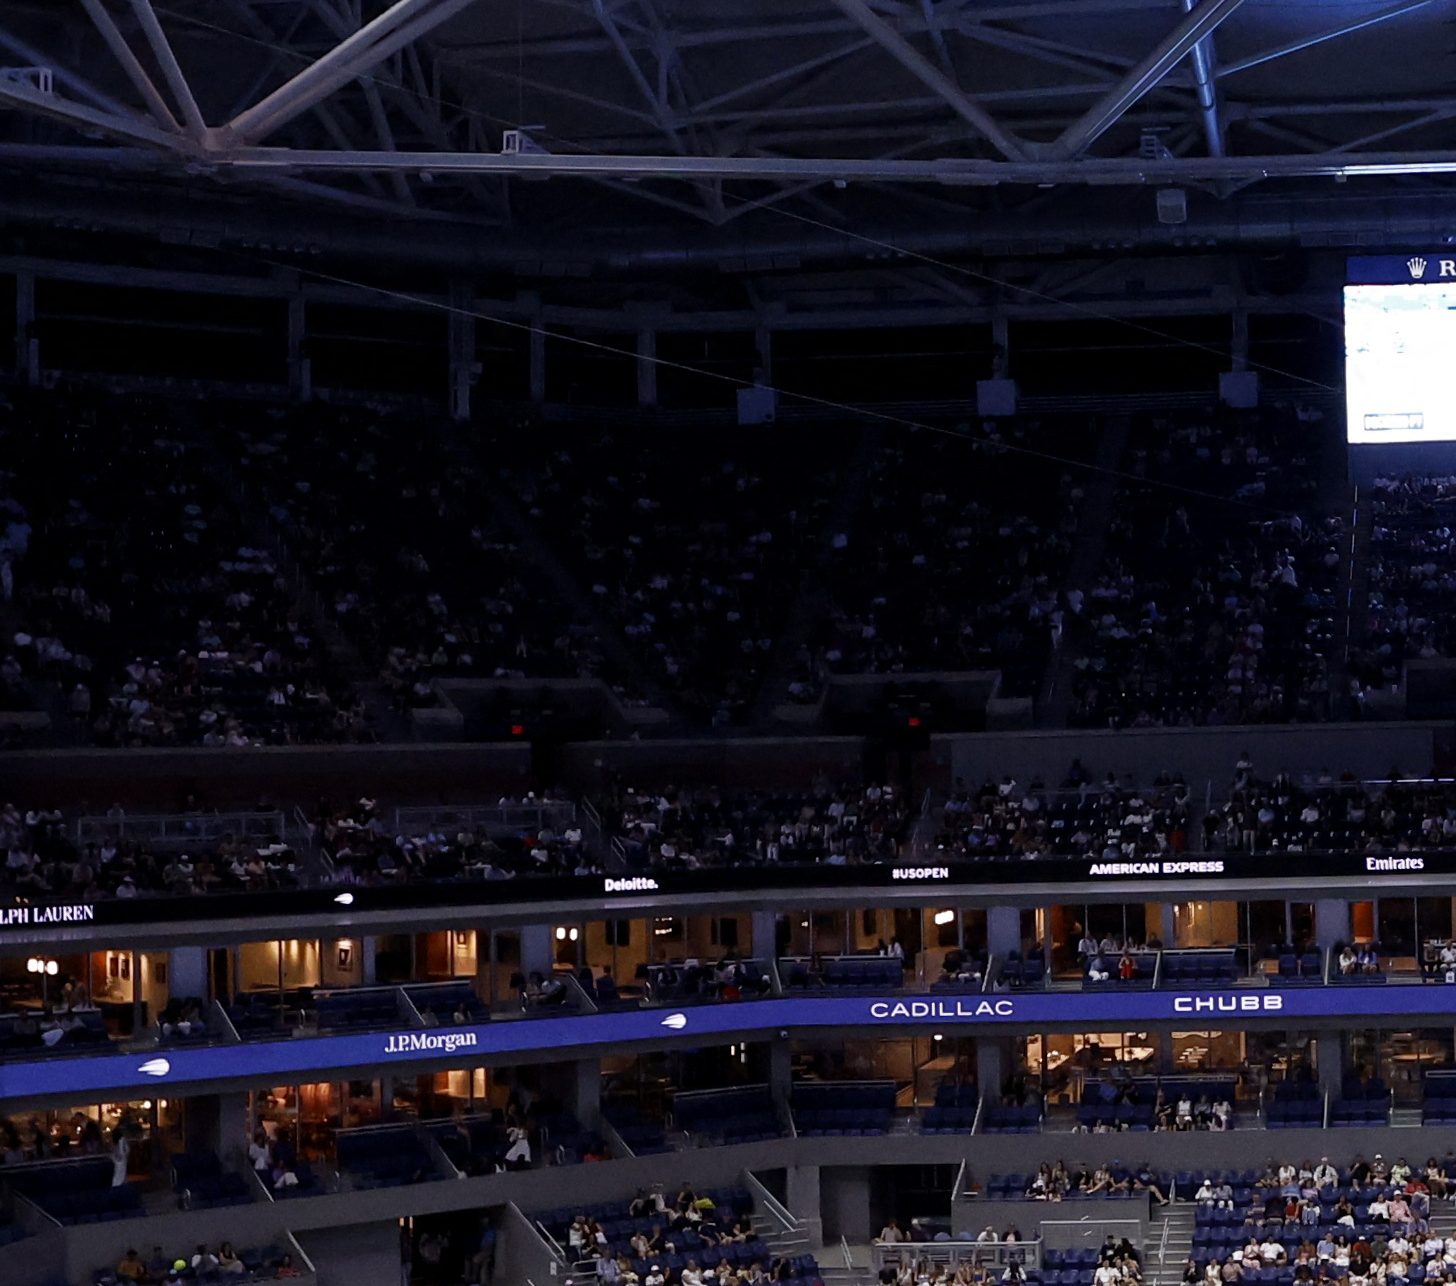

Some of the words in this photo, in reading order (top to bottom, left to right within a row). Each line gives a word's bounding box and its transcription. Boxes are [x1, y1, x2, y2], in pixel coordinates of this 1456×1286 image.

[1090, 863, 1159, 874] AMERICAN
[1163, 862, 1224, 873] EXPRESS
[1367, 857, 1424, 870] Emirates
[893, 868, 948, 879] #USOPEN
[605, 878, 658, 891] Deloitte.
[34, 906, 93, 922] LAUREN
[871, 1001, 1012, 1017] CADILLAC
[1175, 996, 1282, 1011] CHUBB
[385, 1033, 476, 1052] J.P.Morgan
